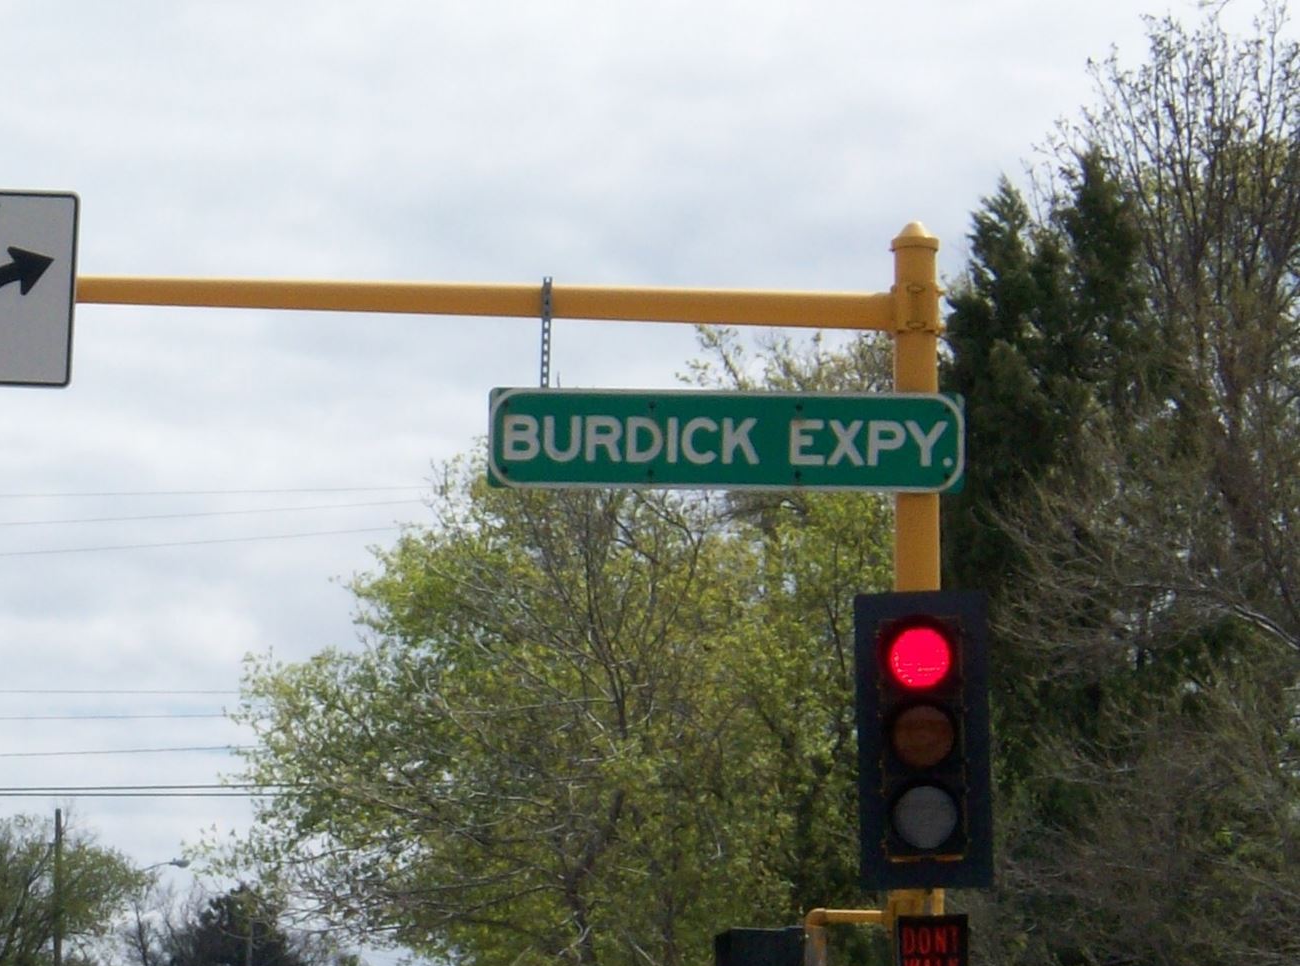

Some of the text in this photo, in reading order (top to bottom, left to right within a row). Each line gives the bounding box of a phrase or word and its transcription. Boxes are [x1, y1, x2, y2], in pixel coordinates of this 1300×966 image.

[502, 413, 955, 468] BURDICK EXPY.
[902, 926, 958, 954] DONT
